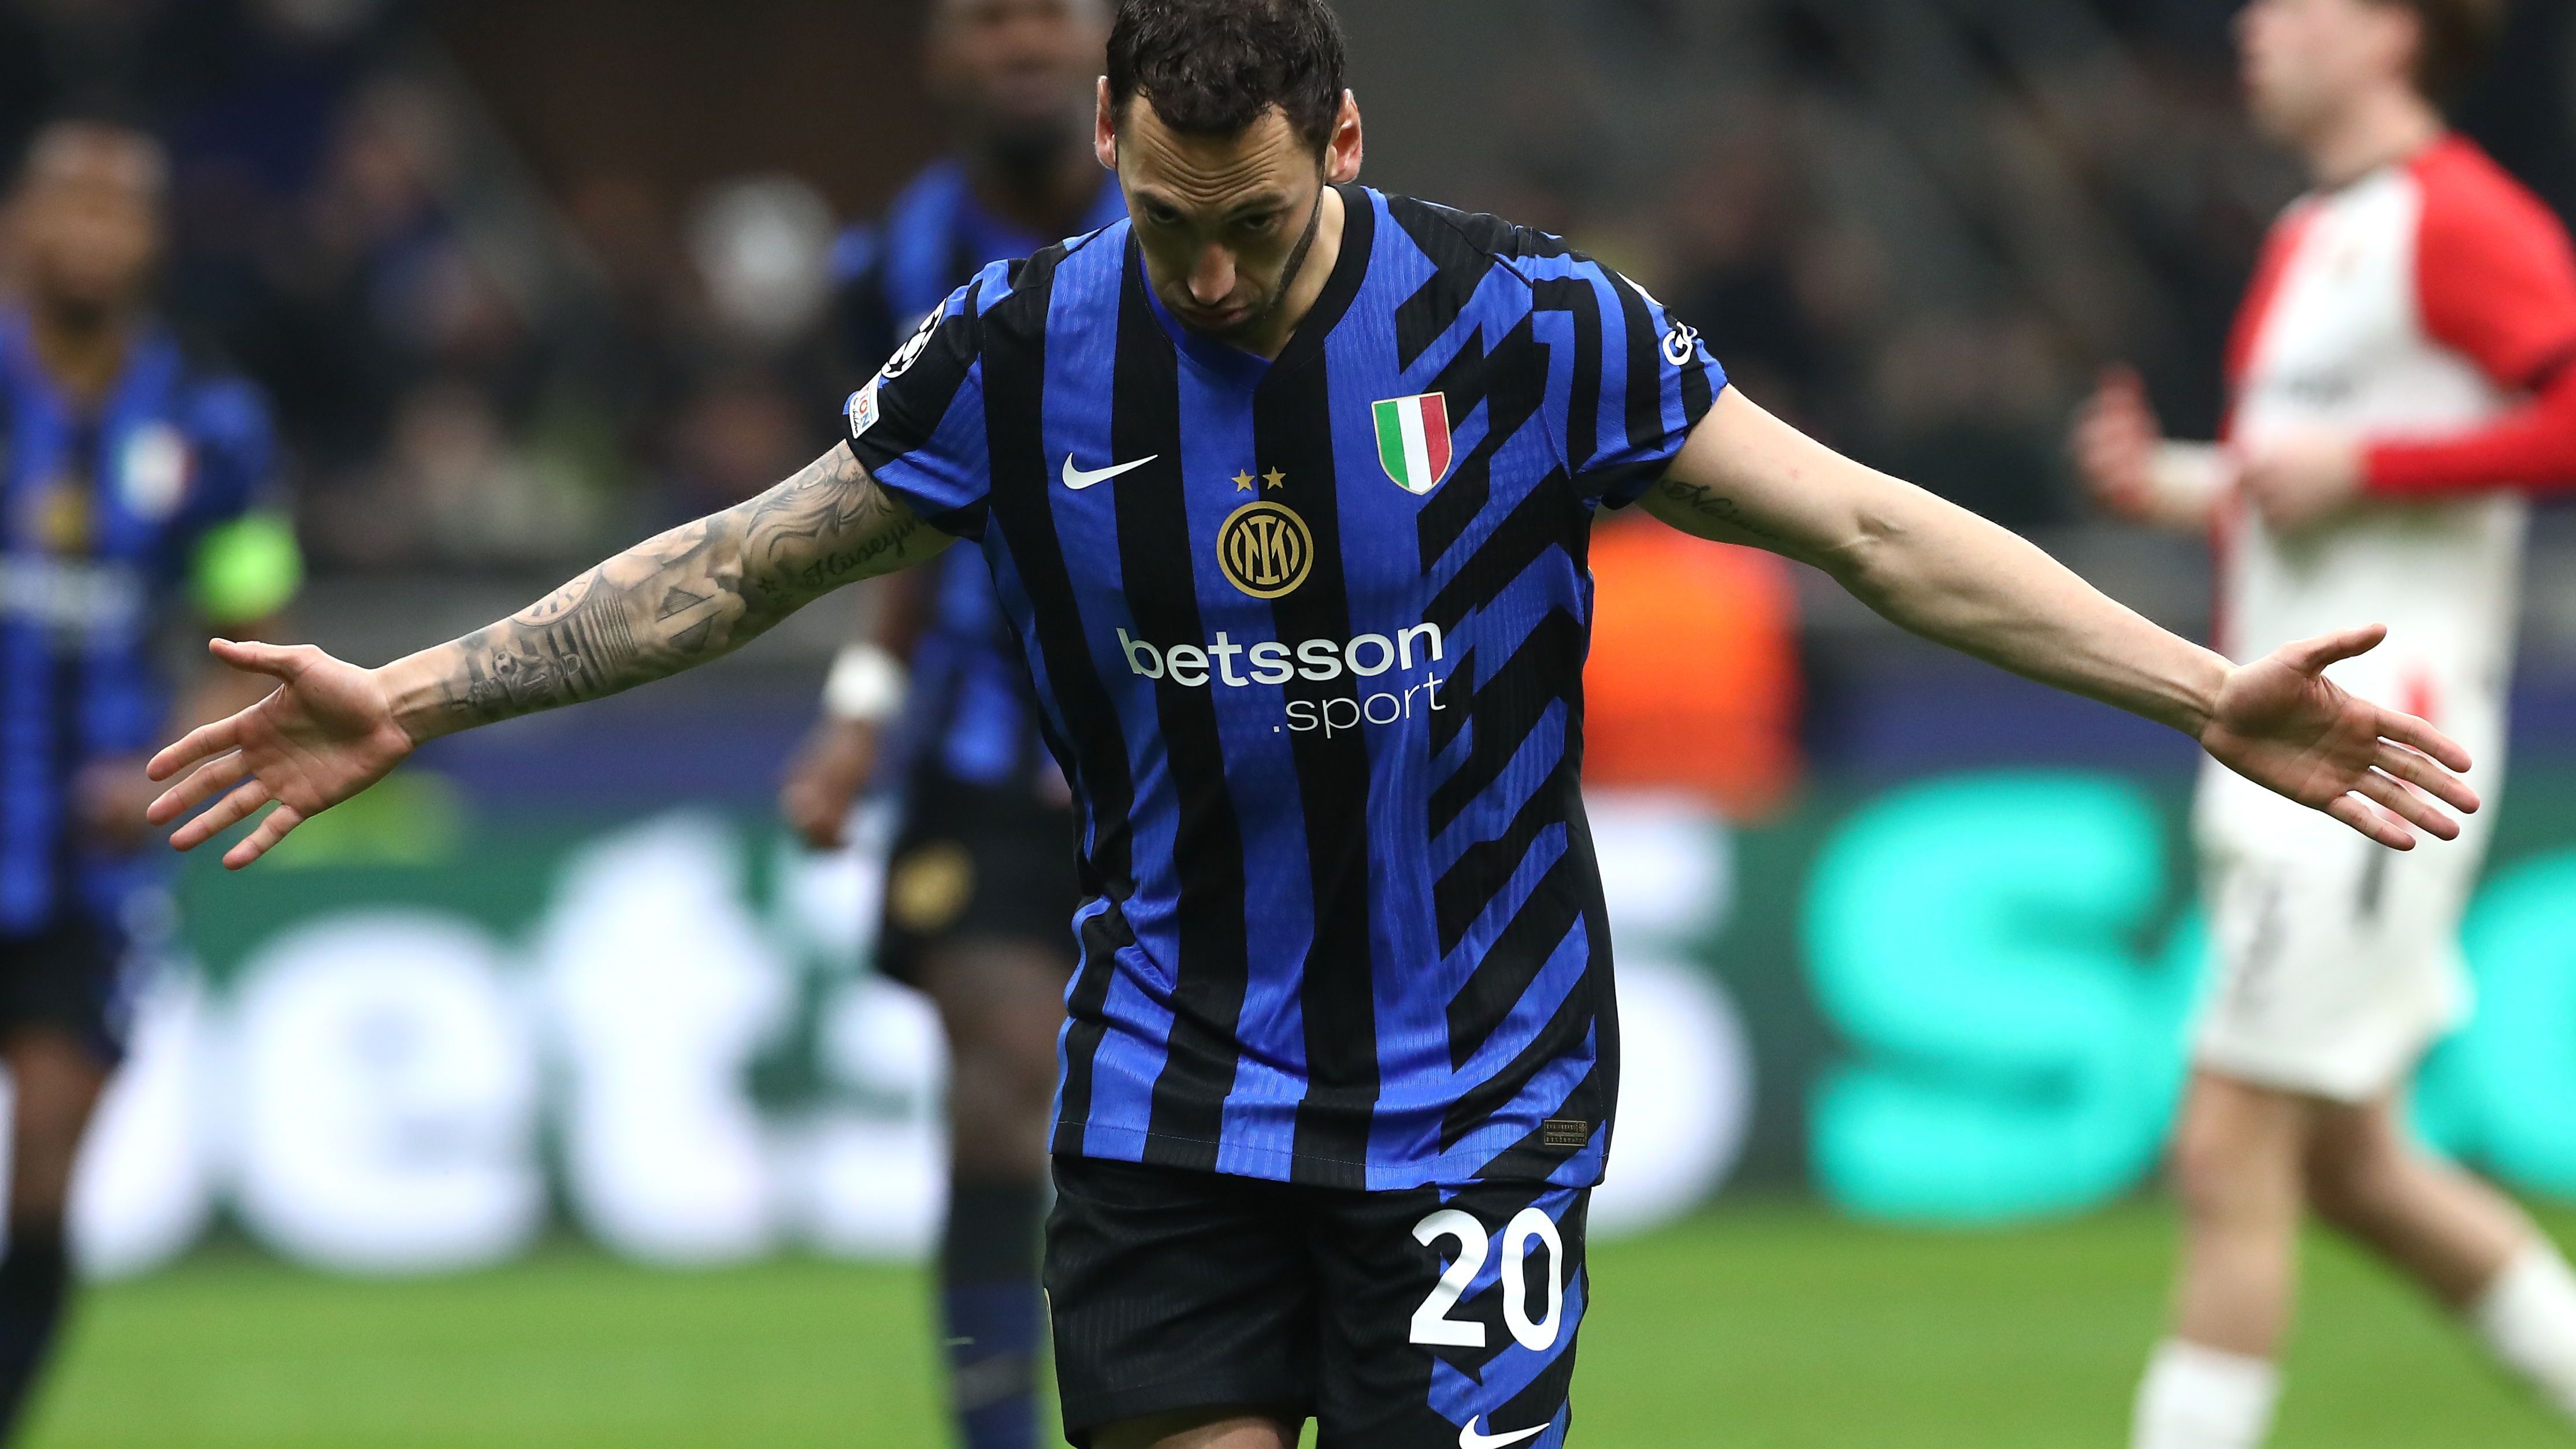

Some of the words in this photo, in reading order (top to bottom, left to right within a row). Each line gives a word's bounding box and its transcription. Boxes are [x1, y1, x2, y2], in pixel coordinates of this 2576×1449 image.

[1116, 622, 1443, 687] betsson
[1273, 672, 1446, 739] .sport
[1409, 1207, 1563, 1351] 20
